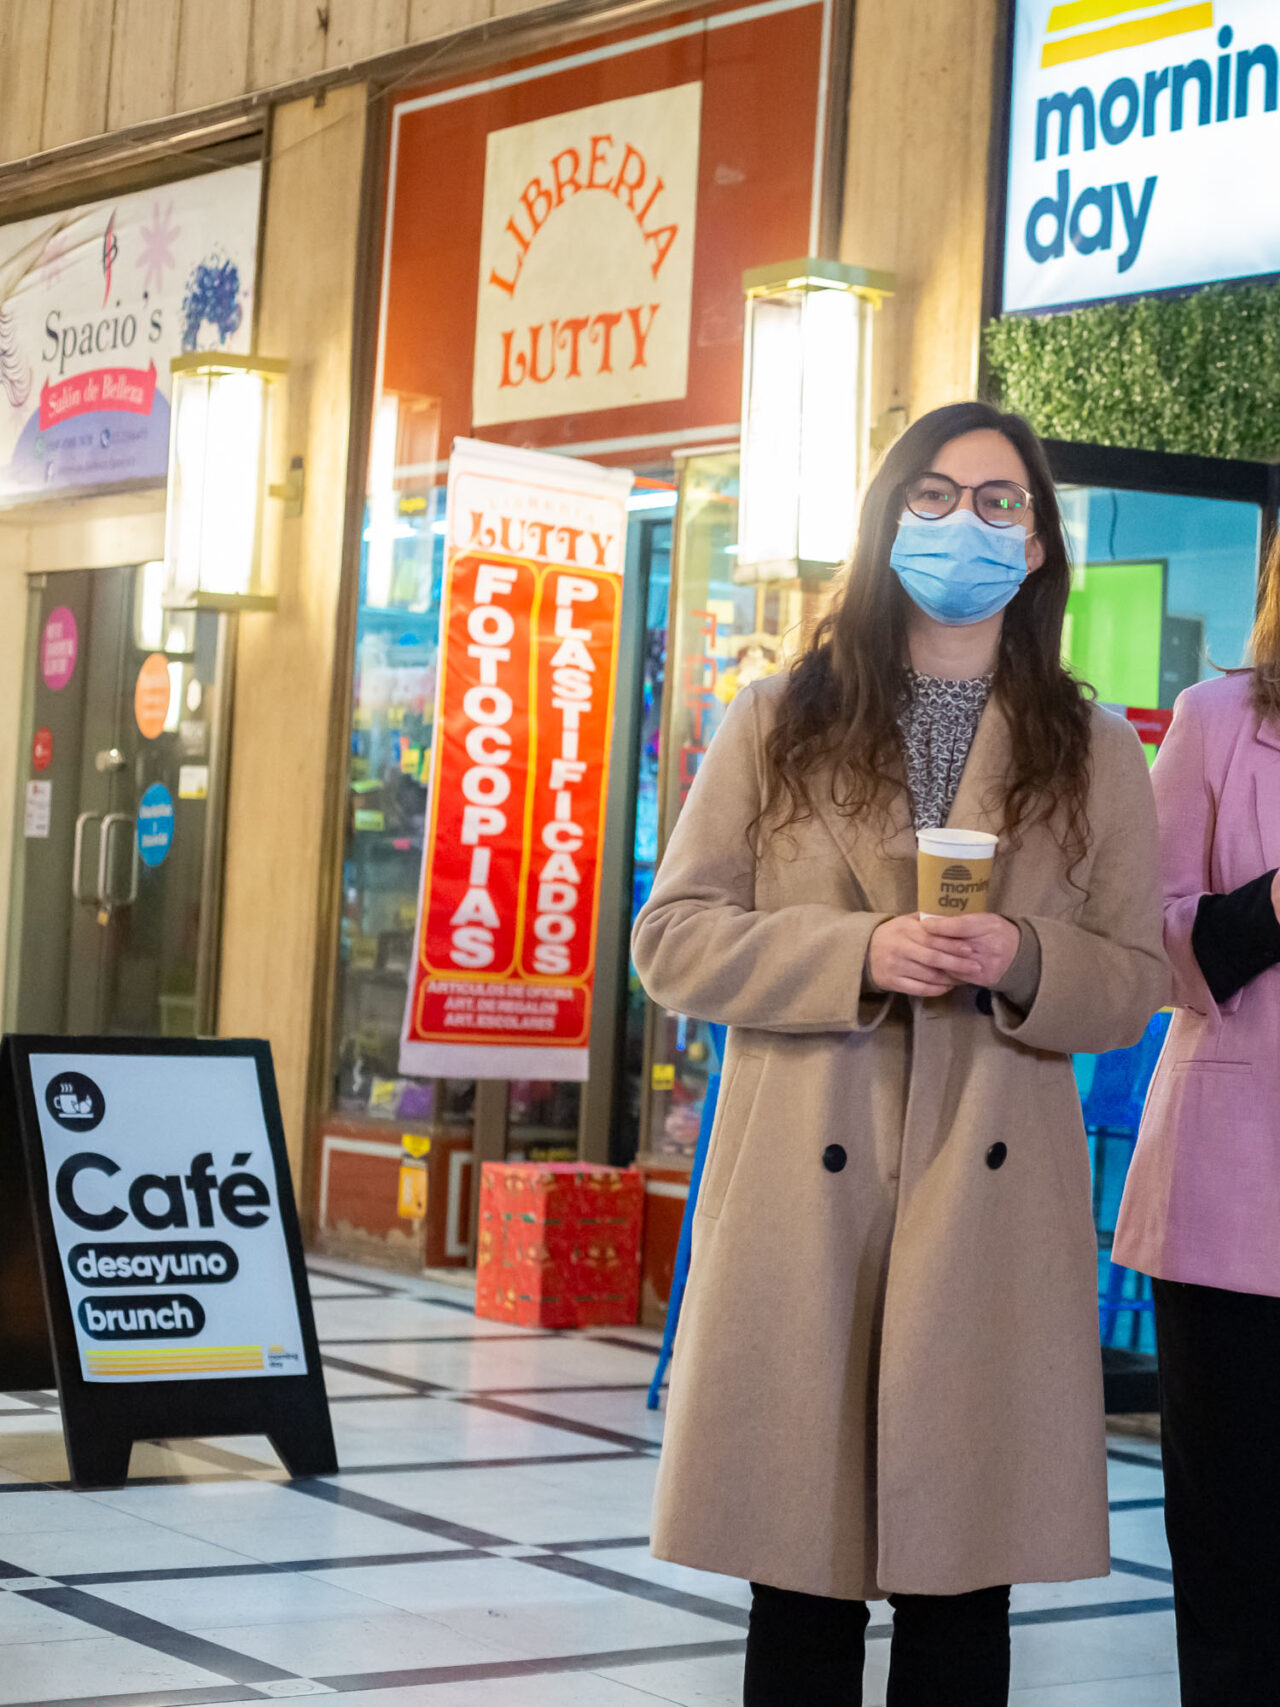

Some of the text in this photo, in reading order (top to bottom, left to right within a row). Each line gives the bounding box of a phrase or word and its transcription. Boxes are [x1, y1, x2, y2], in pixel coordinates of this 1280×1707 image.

[488, 133, 680, 299] LIBRERIA
[1024, 168, 1159, 274] day
[497, 303, 661, 391] LUTTY
[83, 376, 100, 403] de
[469, 510, 614, 567] LUTTY
[448, 563, 518, 970] FOTOCOPIAS
[532, 575, 600, 977] PLASTIFICADOS
[937, 894, 970, 912] day
[54, 1151, 271, 1232] Café
[75, 1248, 229, 1284] desayuno
[84, 1301, 195, 1333] brunch
